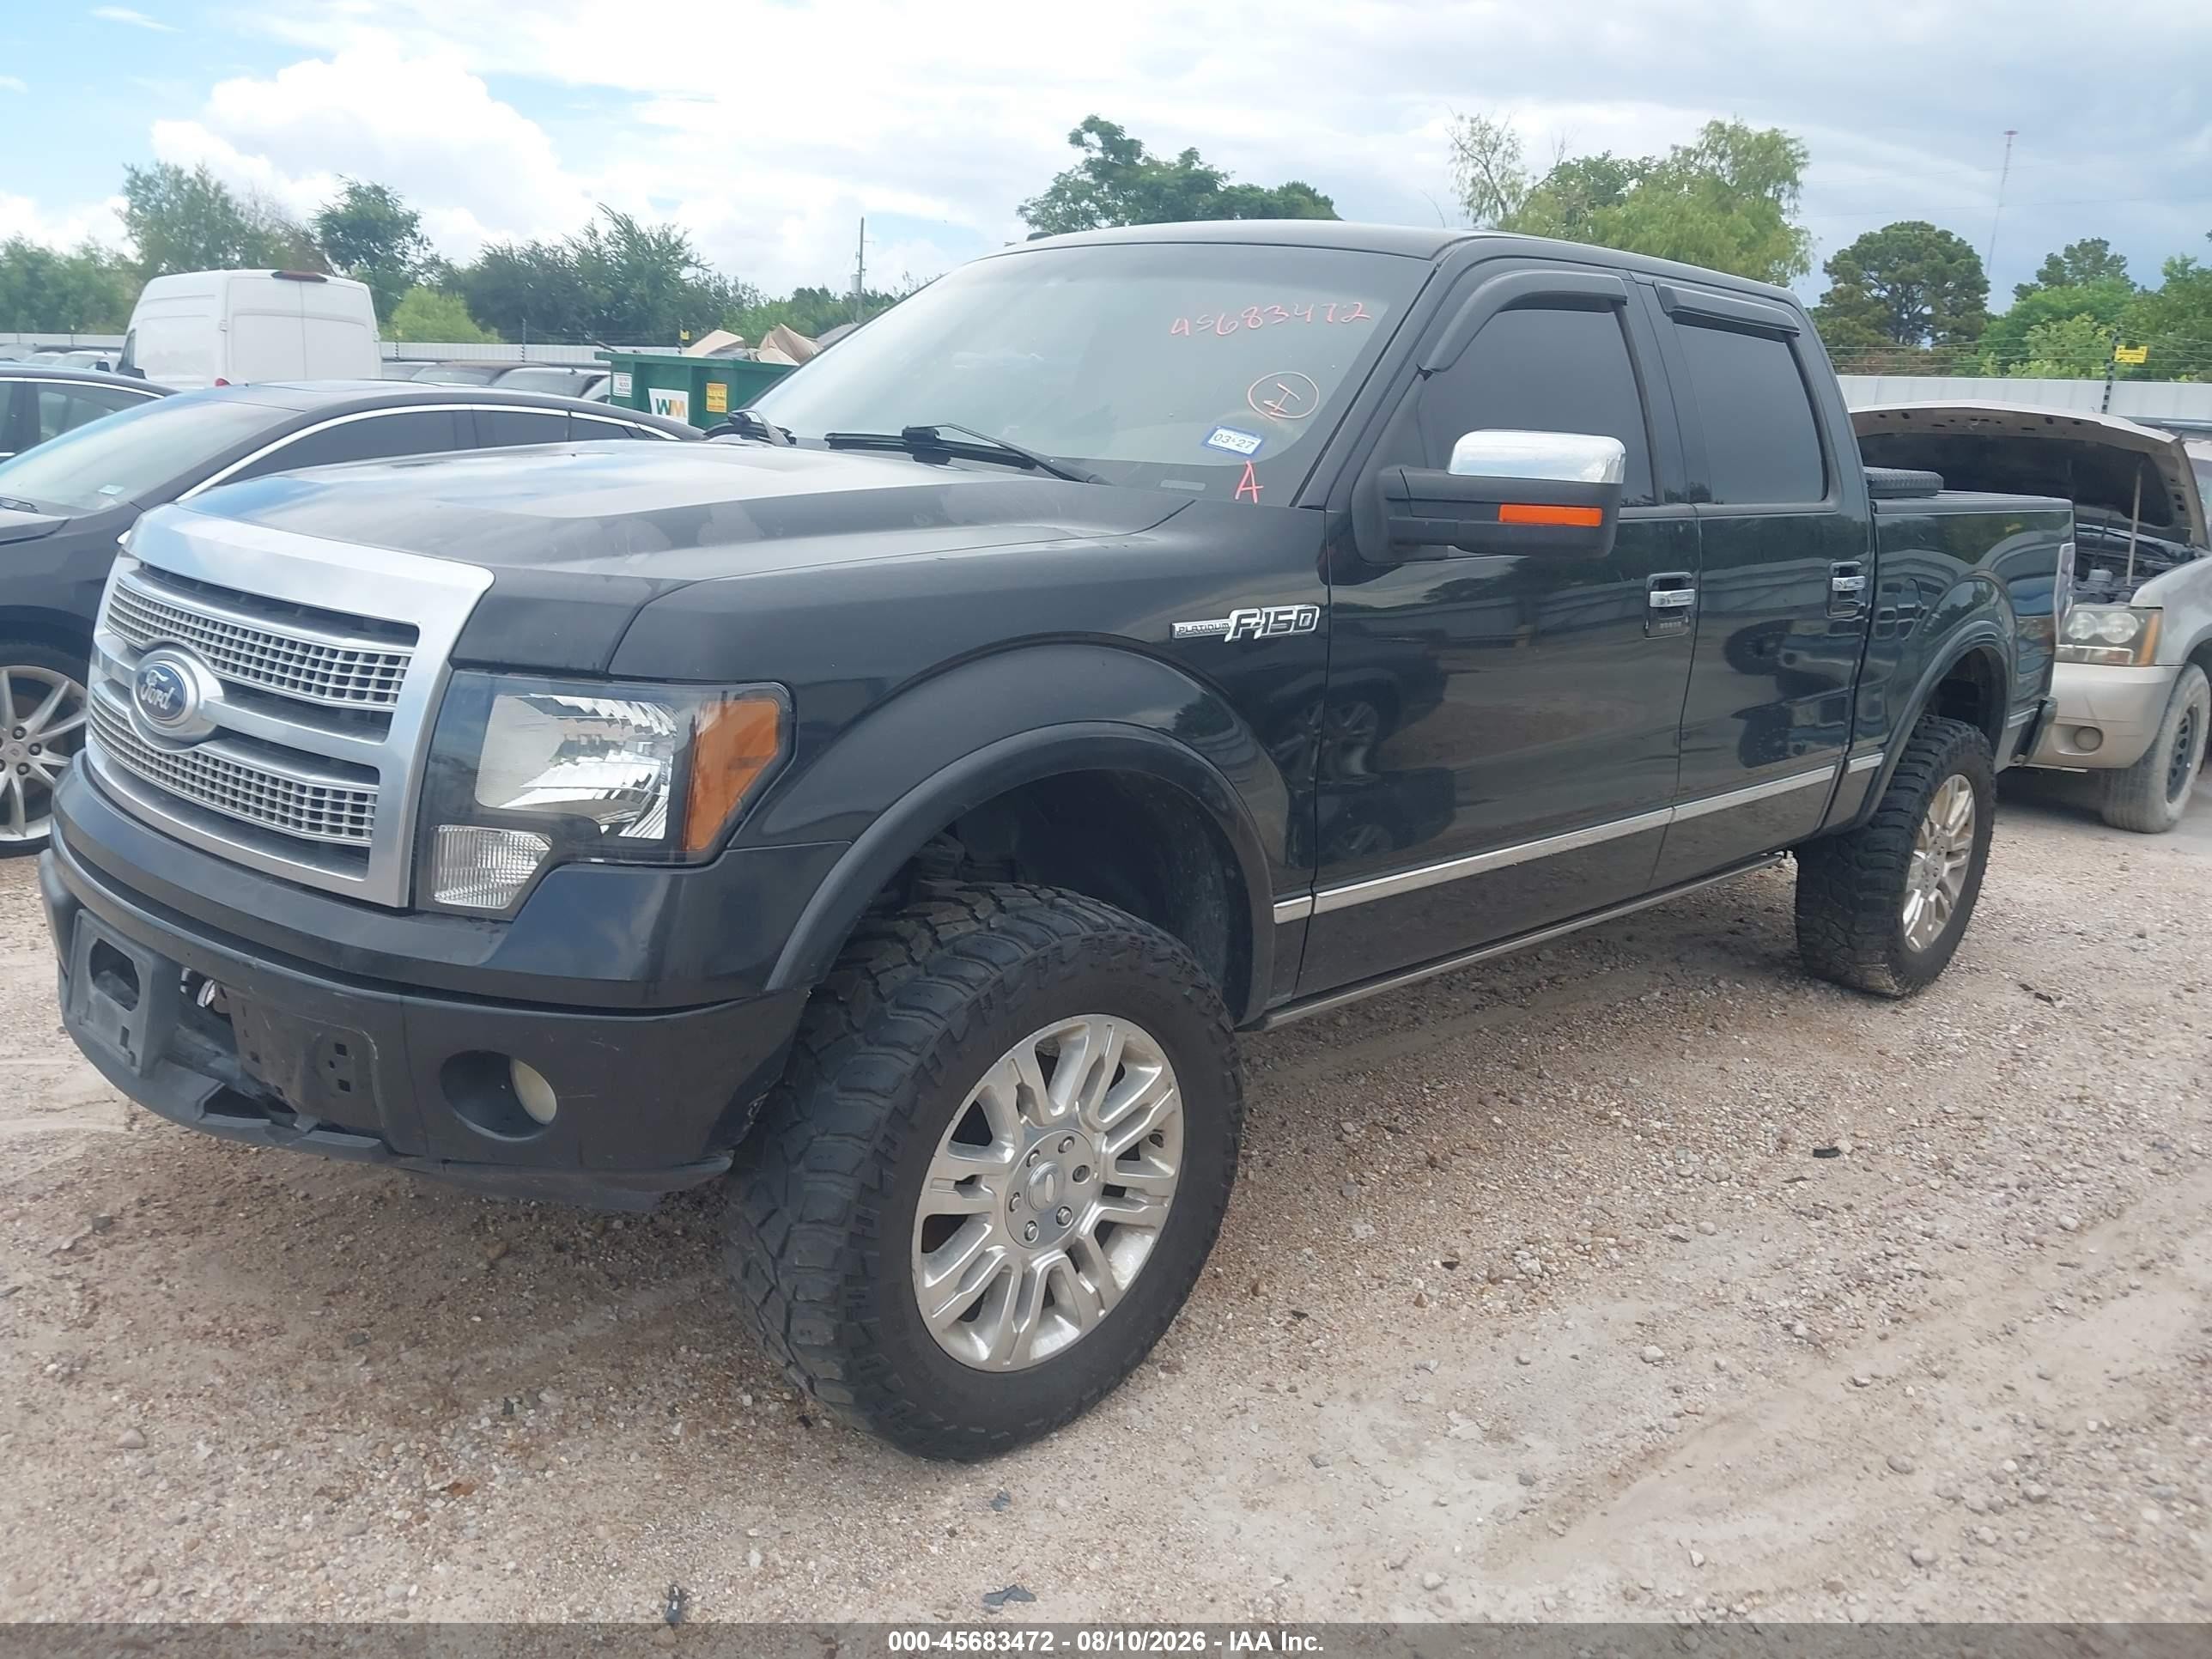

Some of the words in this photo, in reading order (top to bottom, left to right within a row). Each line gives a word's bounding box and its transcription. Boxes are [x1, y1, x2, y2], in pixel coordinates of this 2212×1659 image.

[1169, 301, 1372, 337] 45683472
[655, 398, 688, 418] WM
[1213, 433, 1232, 444] 03
[1234, 459, 1264, 504] A
[1177, 622, 1230, 634] PLATINUM
[140, 668, 176, 710] Ford
